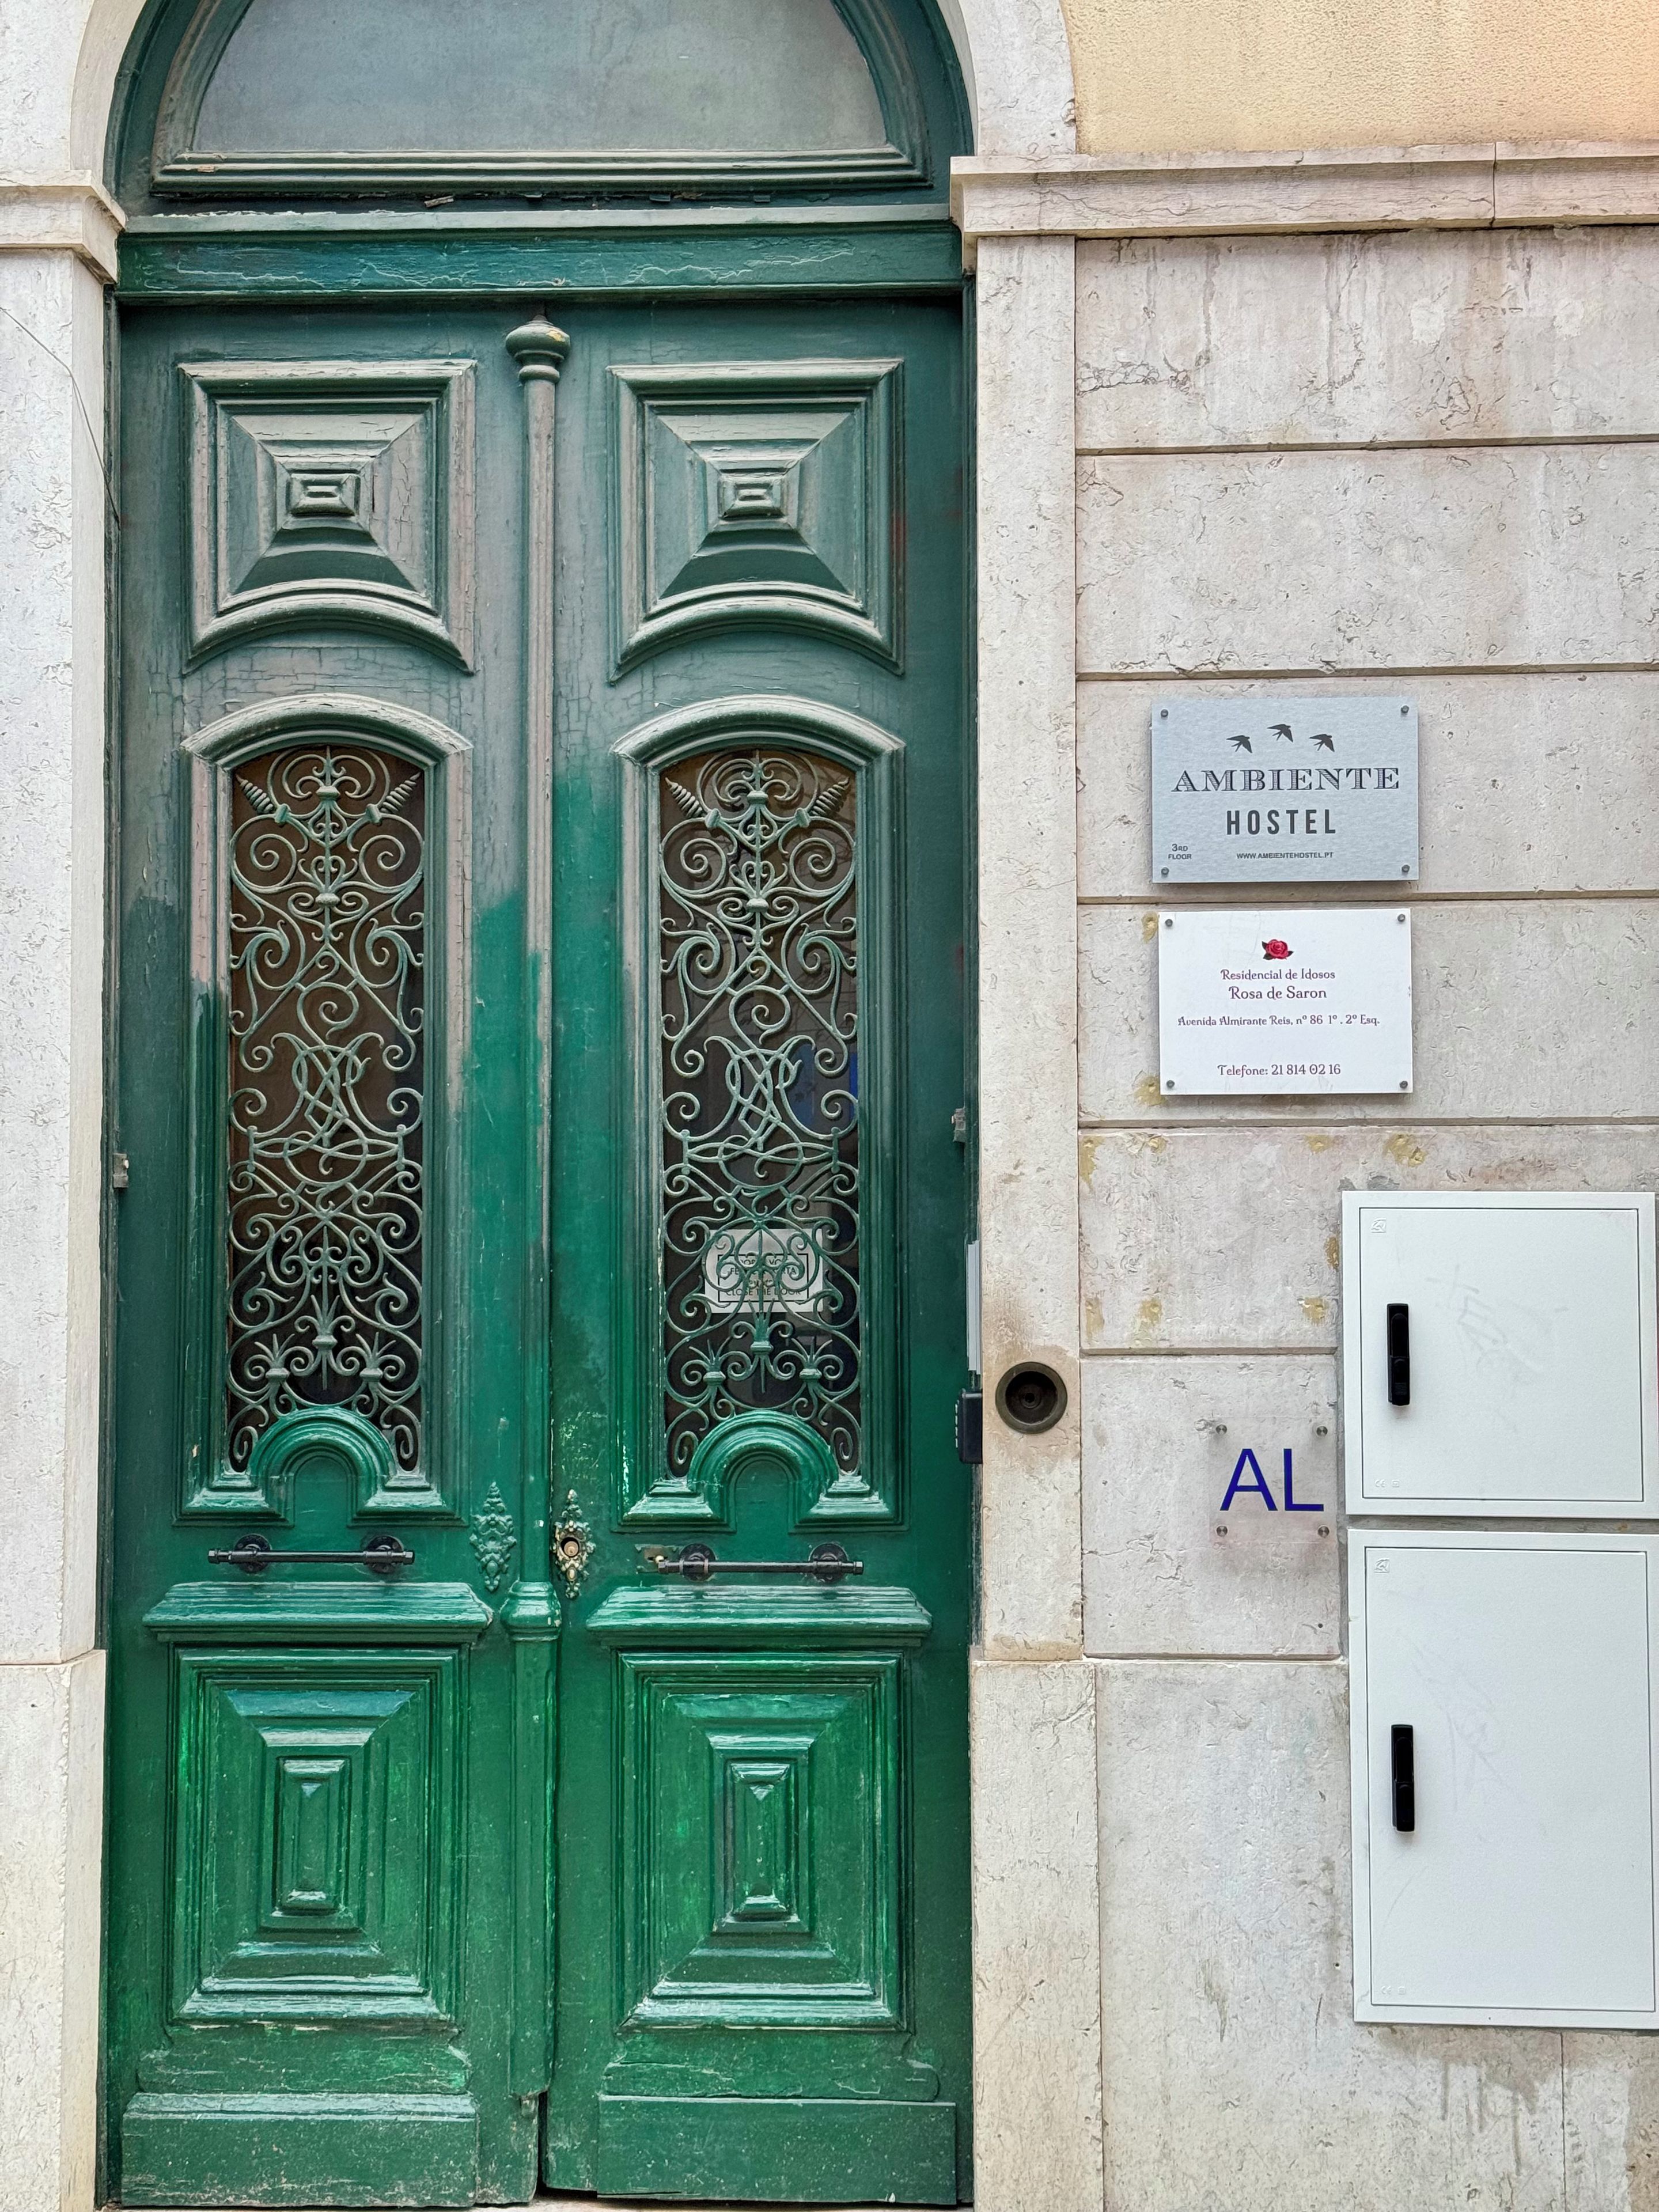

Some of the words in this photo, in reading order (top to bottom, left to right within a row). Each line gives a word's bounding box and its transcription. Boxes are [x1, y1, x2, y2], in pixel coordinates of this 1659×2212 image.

[1171, 767, 1399, 792] AMBIENTE
[1226, 809, 1336, 835] HOSTEL
[1172, 843, 1188, 852] 3RD
[1236, 851, 1334, 859] WWW.AMBIENTEHOSTEL.PT
[1220, 968, 1282, 981] Residencial
[1285, 968, 1298, 980] de
[1301, 968, 1335, 980] Idosos
[1228, 986, 1263, 999] Rosa
[1267, 986, 1282, 1001] de
[1286, 985, 1327, 999] Saron
[1177, 1016, 1217, 1027] Avenida
[1219, 1016, 1267, 1027] Almirante
[1268, 1015, 1294, 1025] Reis,
[1309, 1014, 1323, 1025] 86
[1360, 1014, 1380, 1027] Esq.
[1217, 1064, 1268, 1078] Telefone:
[1271, 1064, 1283, 1075] 21
[1286, 1064, 1306, 1075] 814
[1309, 1063, 1326, 1075] 02
[1328, 1063, 1341, 1075] 16
[1219, 1448, 1324, 1512] AL
